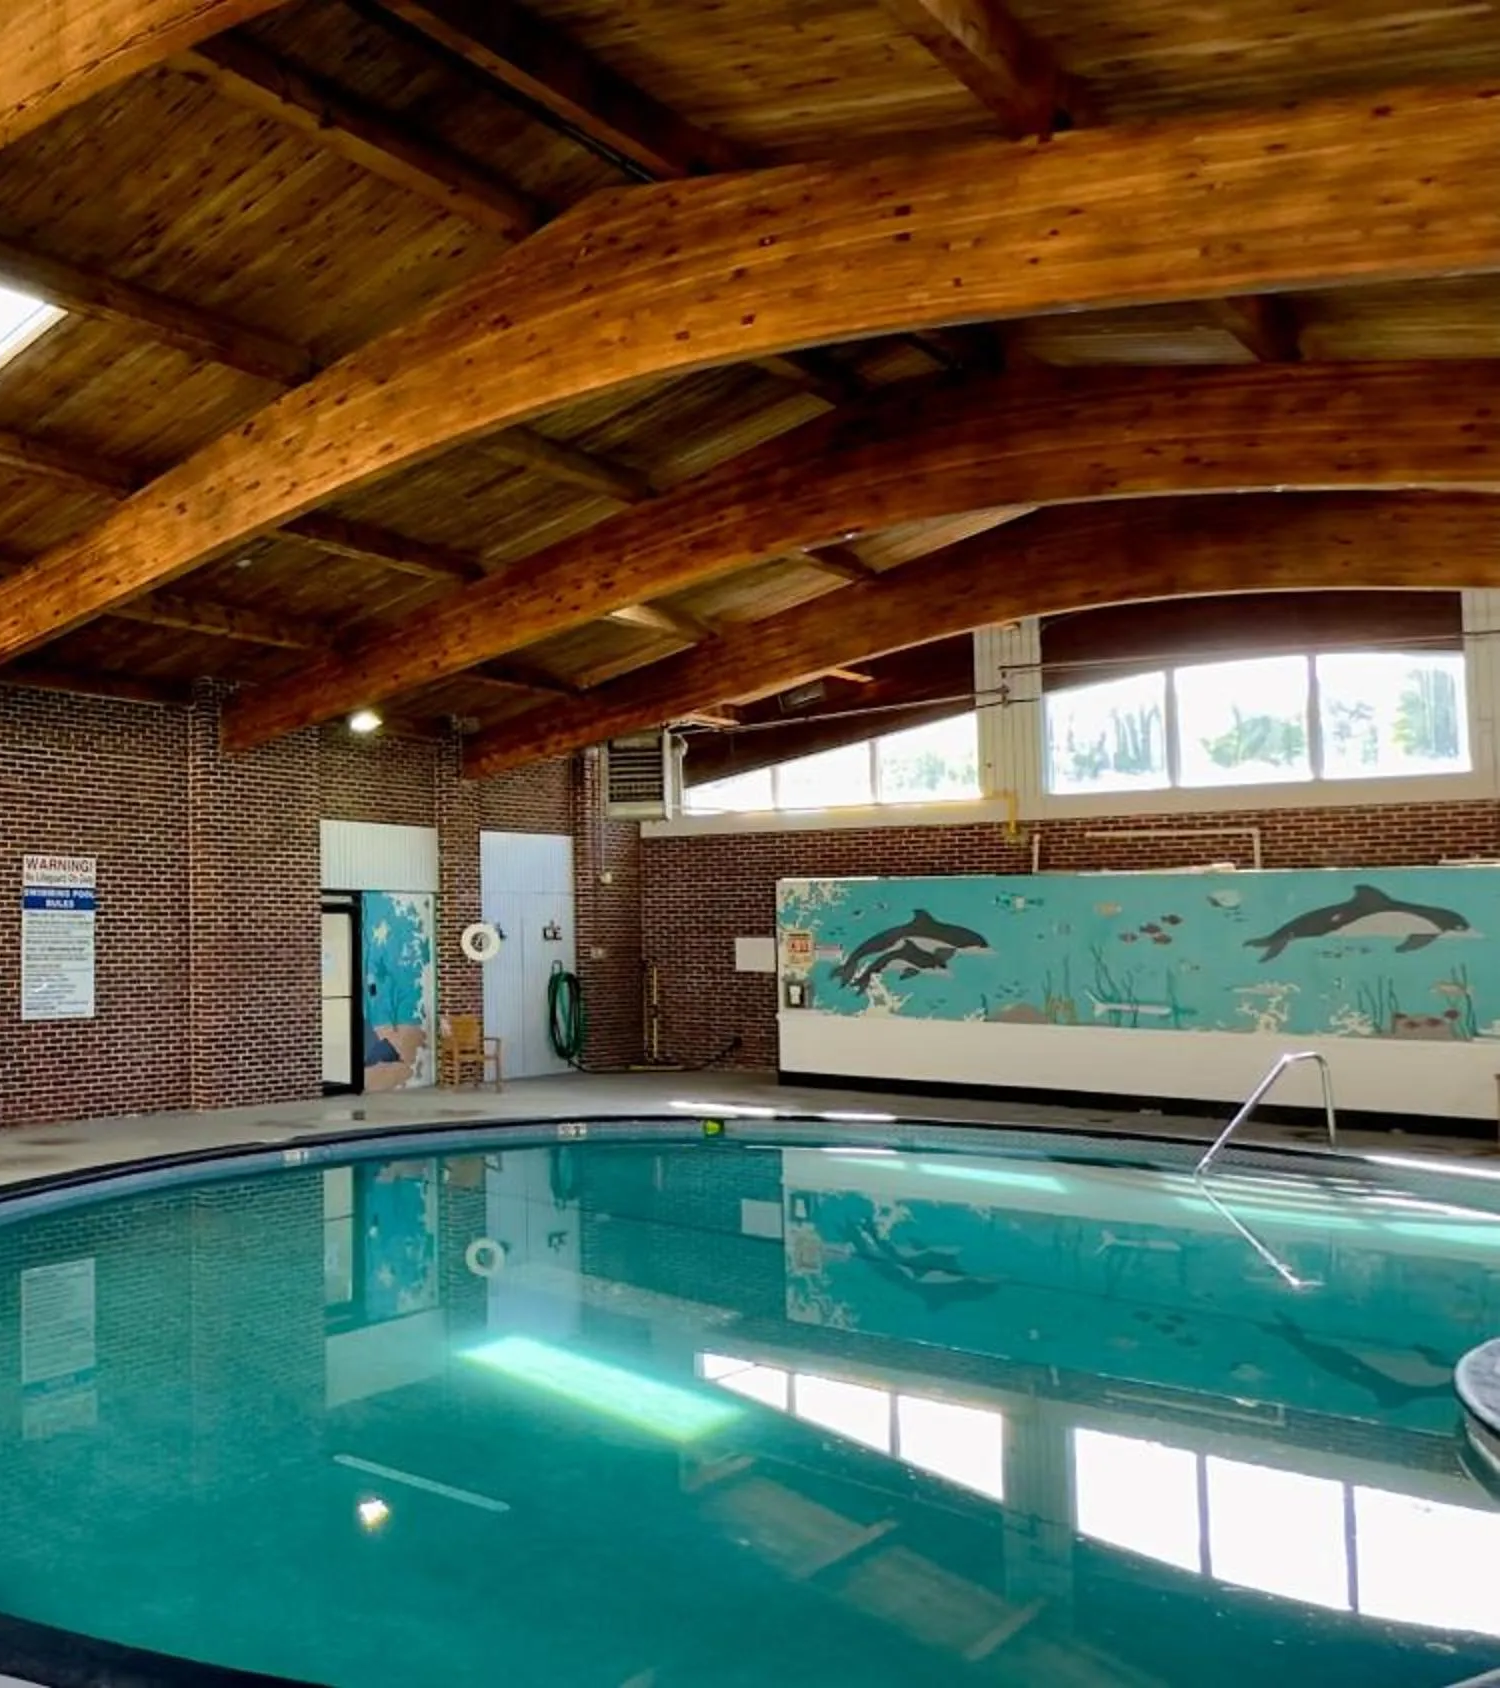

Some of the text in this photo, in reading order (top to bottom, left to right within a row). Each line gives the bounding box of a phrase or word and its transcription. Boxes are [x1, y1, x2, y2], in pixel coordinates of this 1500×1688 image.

[26, 857, 93, 873] WARNING!
[72, 889, 95, 899] POOL
[45, 899, 75, 909] RULES
